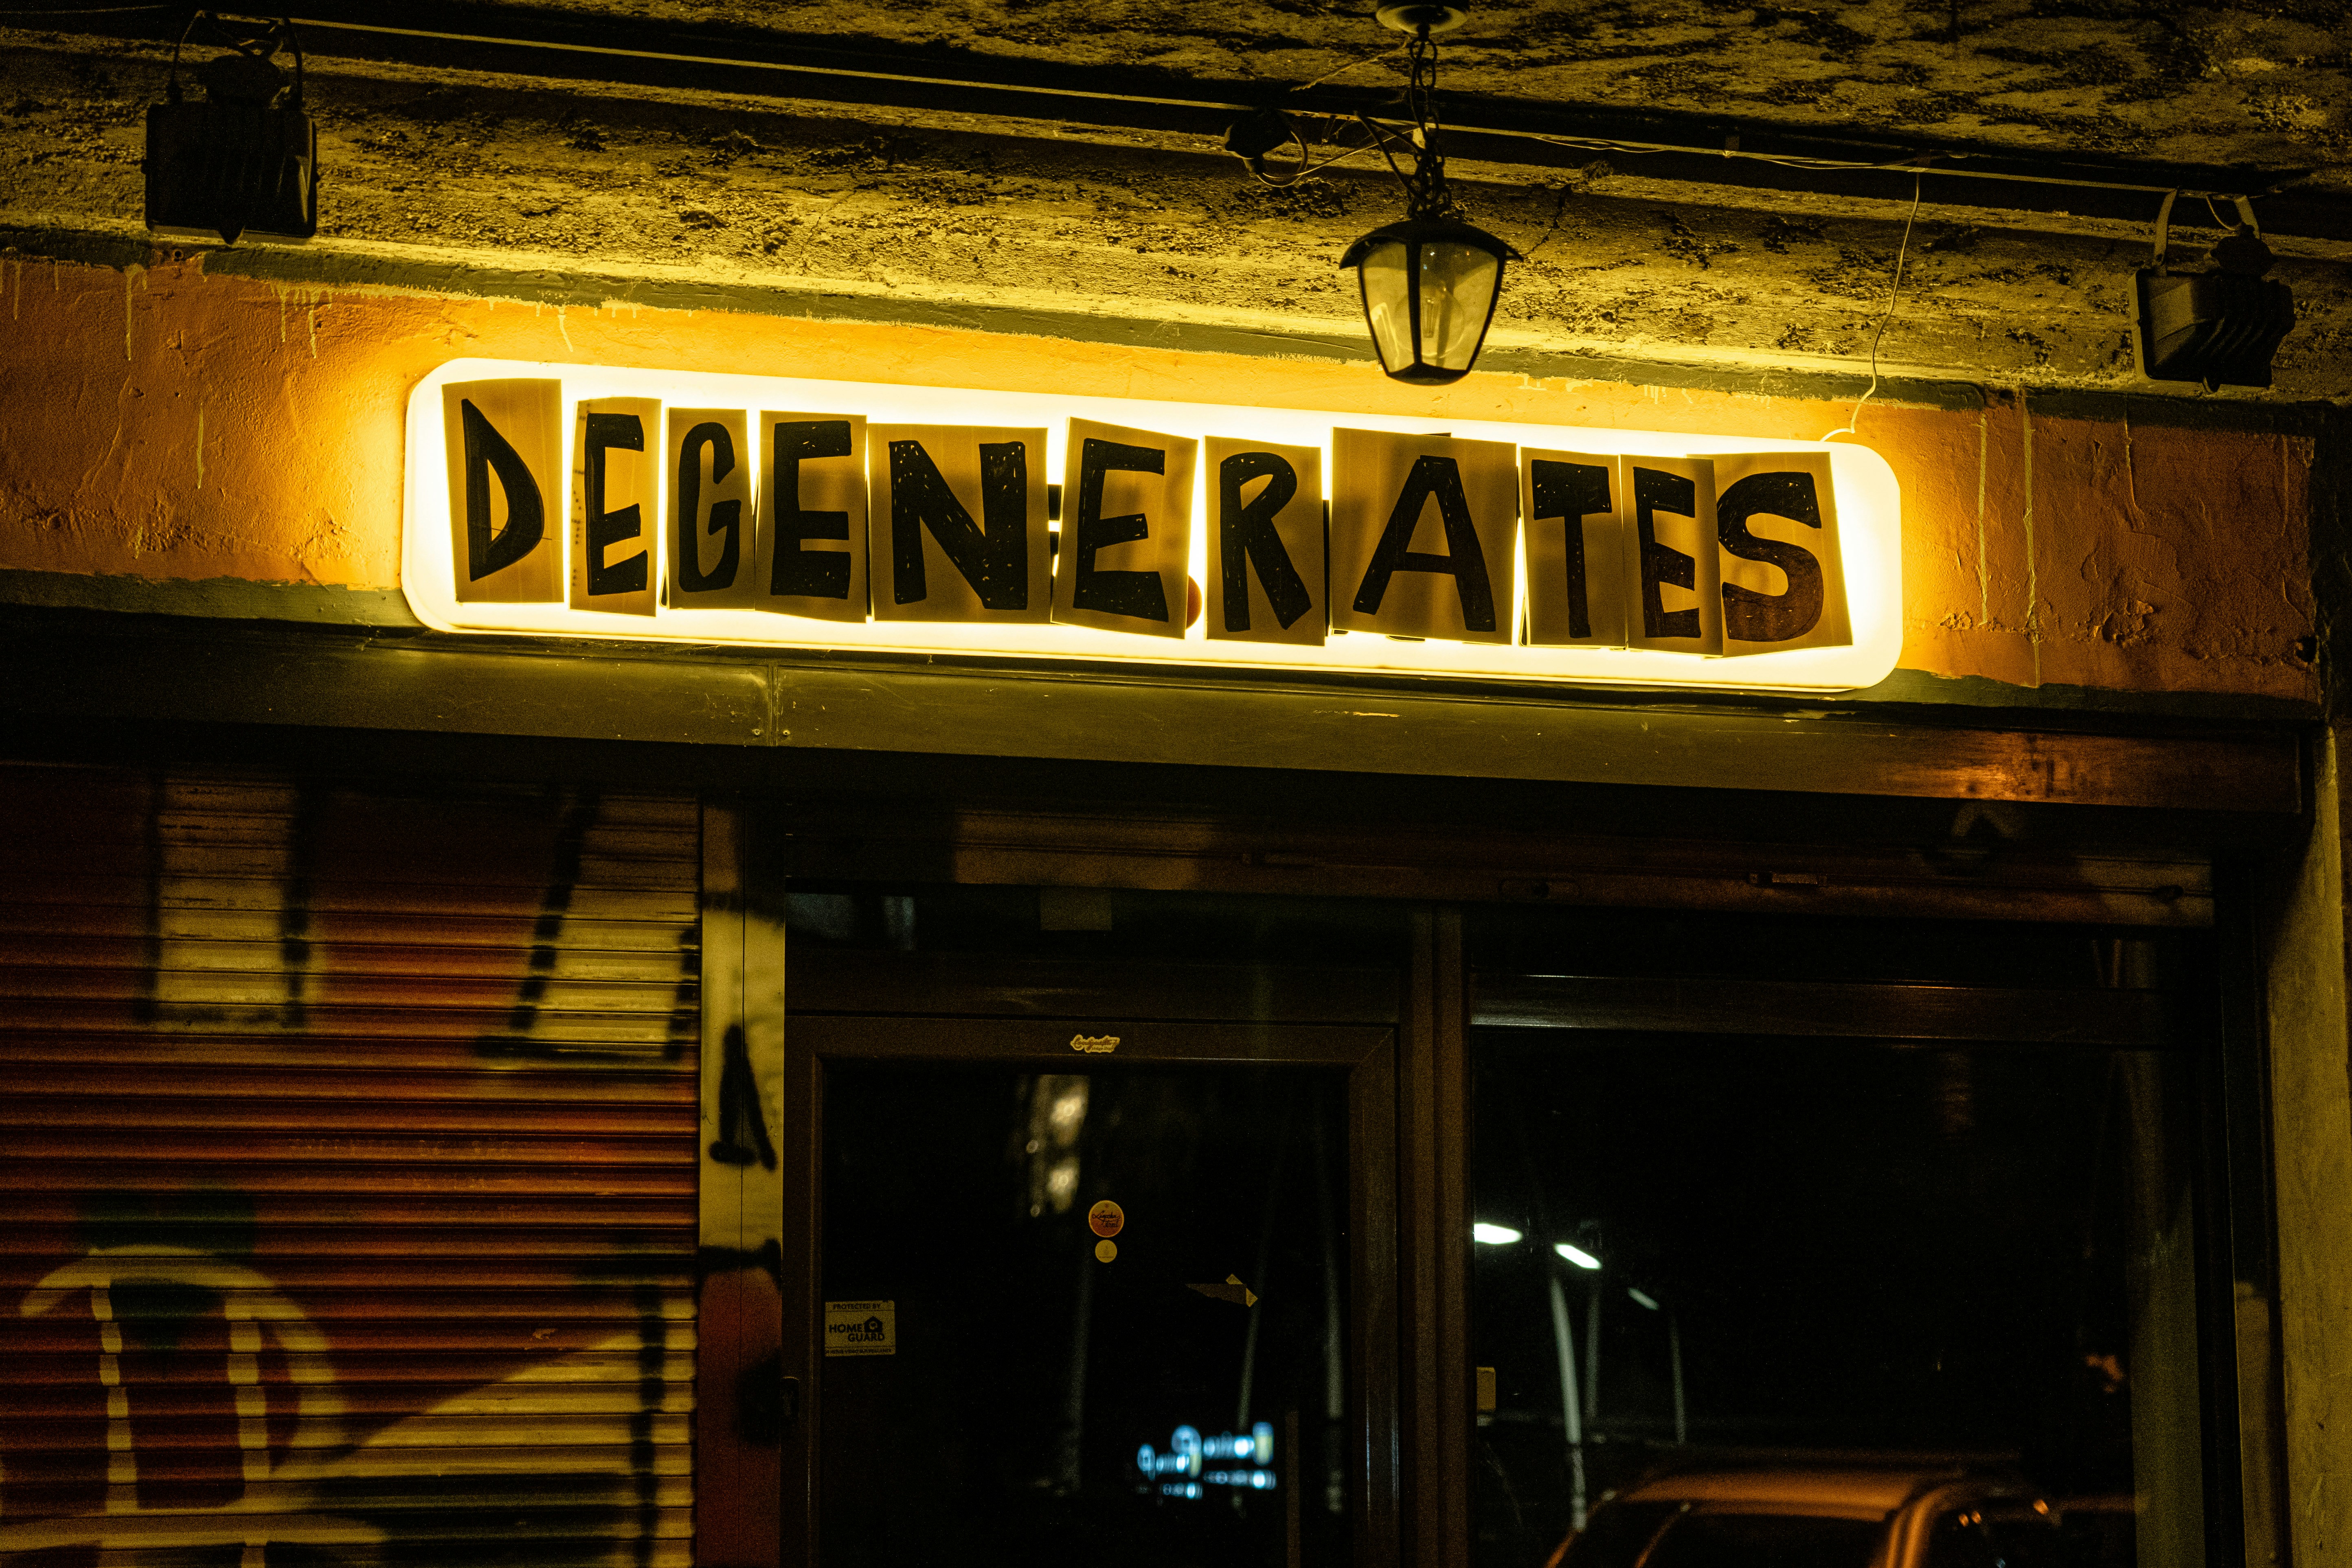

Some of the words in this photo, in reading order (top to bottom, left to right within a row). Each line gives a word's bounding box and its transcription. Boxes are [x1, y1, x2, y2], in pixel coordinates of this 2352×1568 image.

[462, 399, 1824, 643] DEGENERATES
[829, 1324, 862, 1333] HOME
[848, 1333, 885, 1342] GUARD
